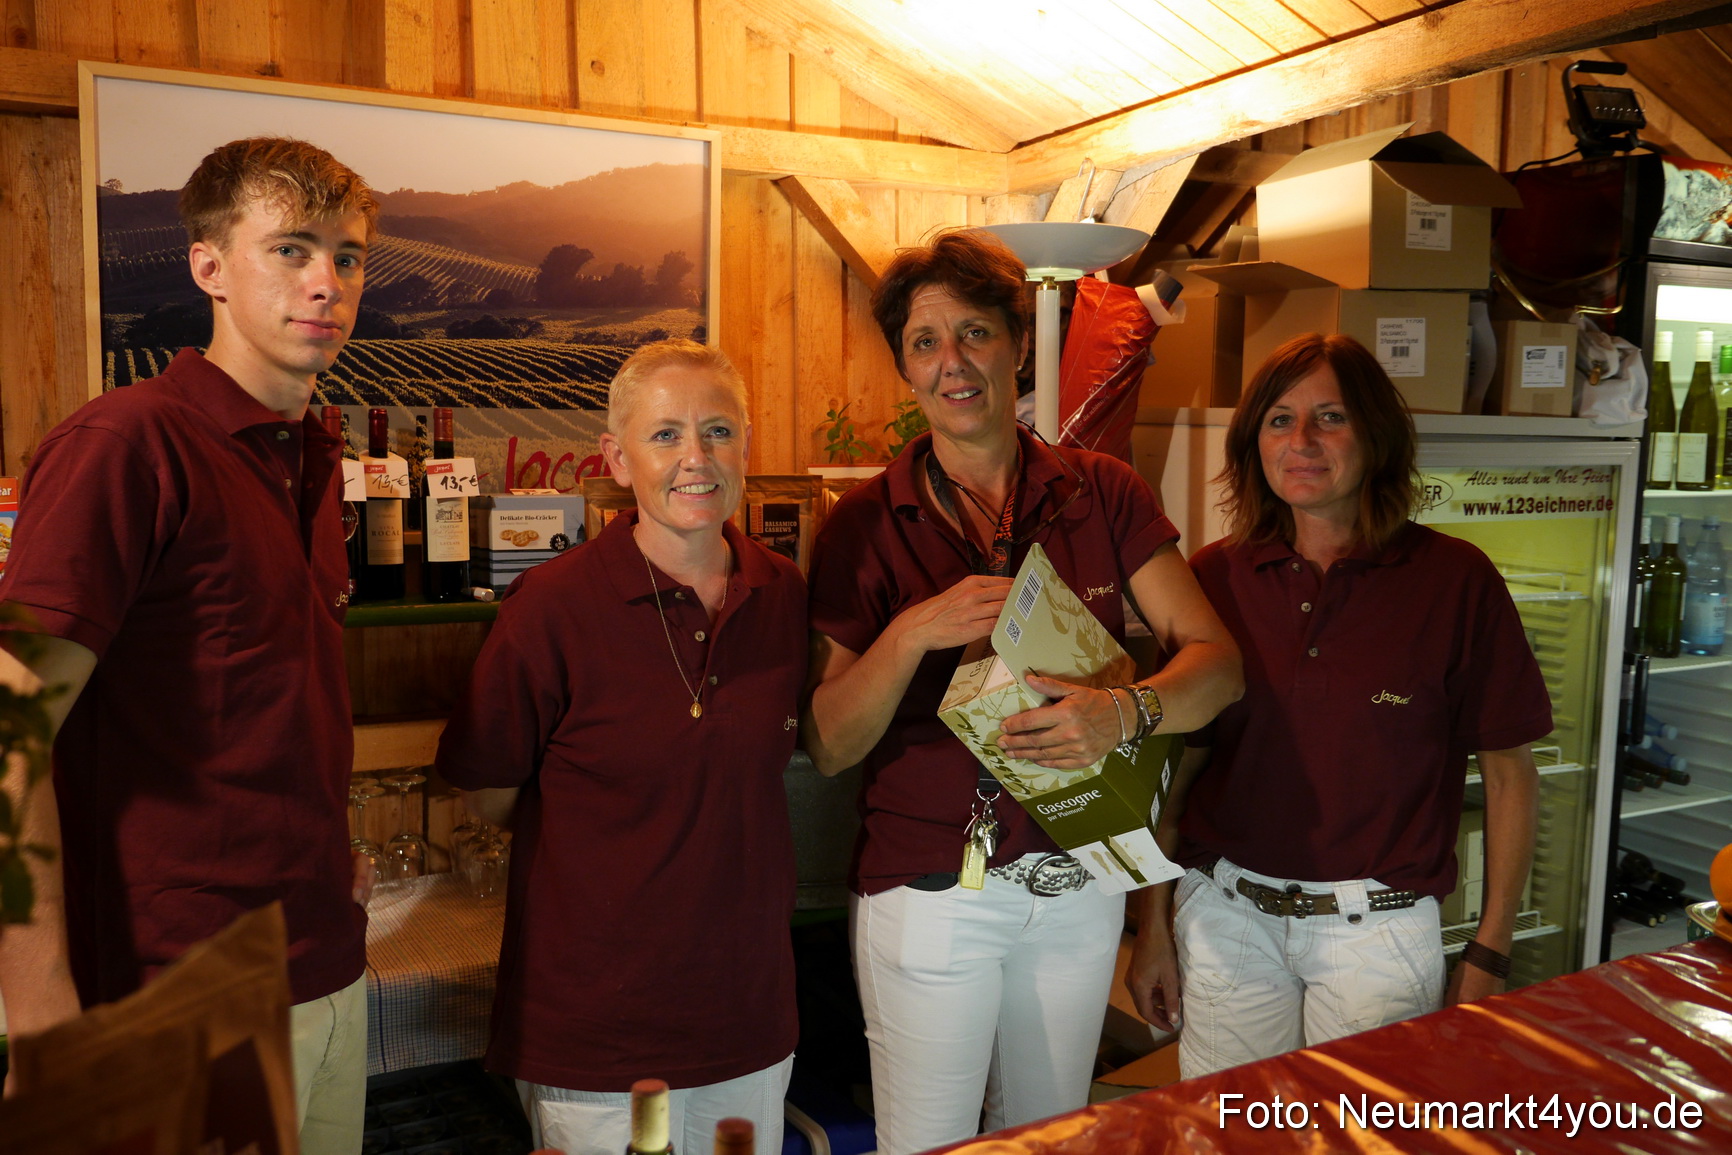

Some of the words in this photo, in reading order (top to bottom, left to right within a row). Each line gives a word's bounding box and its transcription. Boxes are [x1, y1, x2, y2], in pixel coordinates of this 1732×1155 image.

[1464, 470, 1498, 487] Alles
[1502, 472, 1530, 485] rund
[1533, 473, 1551, 485] um
[1555, 469, 1578, 485] Ihre
[1463, 495, 1615, 516] www.123eichner.de
[1036, 789, 1102, 815] Gascogne
[1047, 814, 1058, 822] par
[1058, 806, 1085, 818] Plaimont
